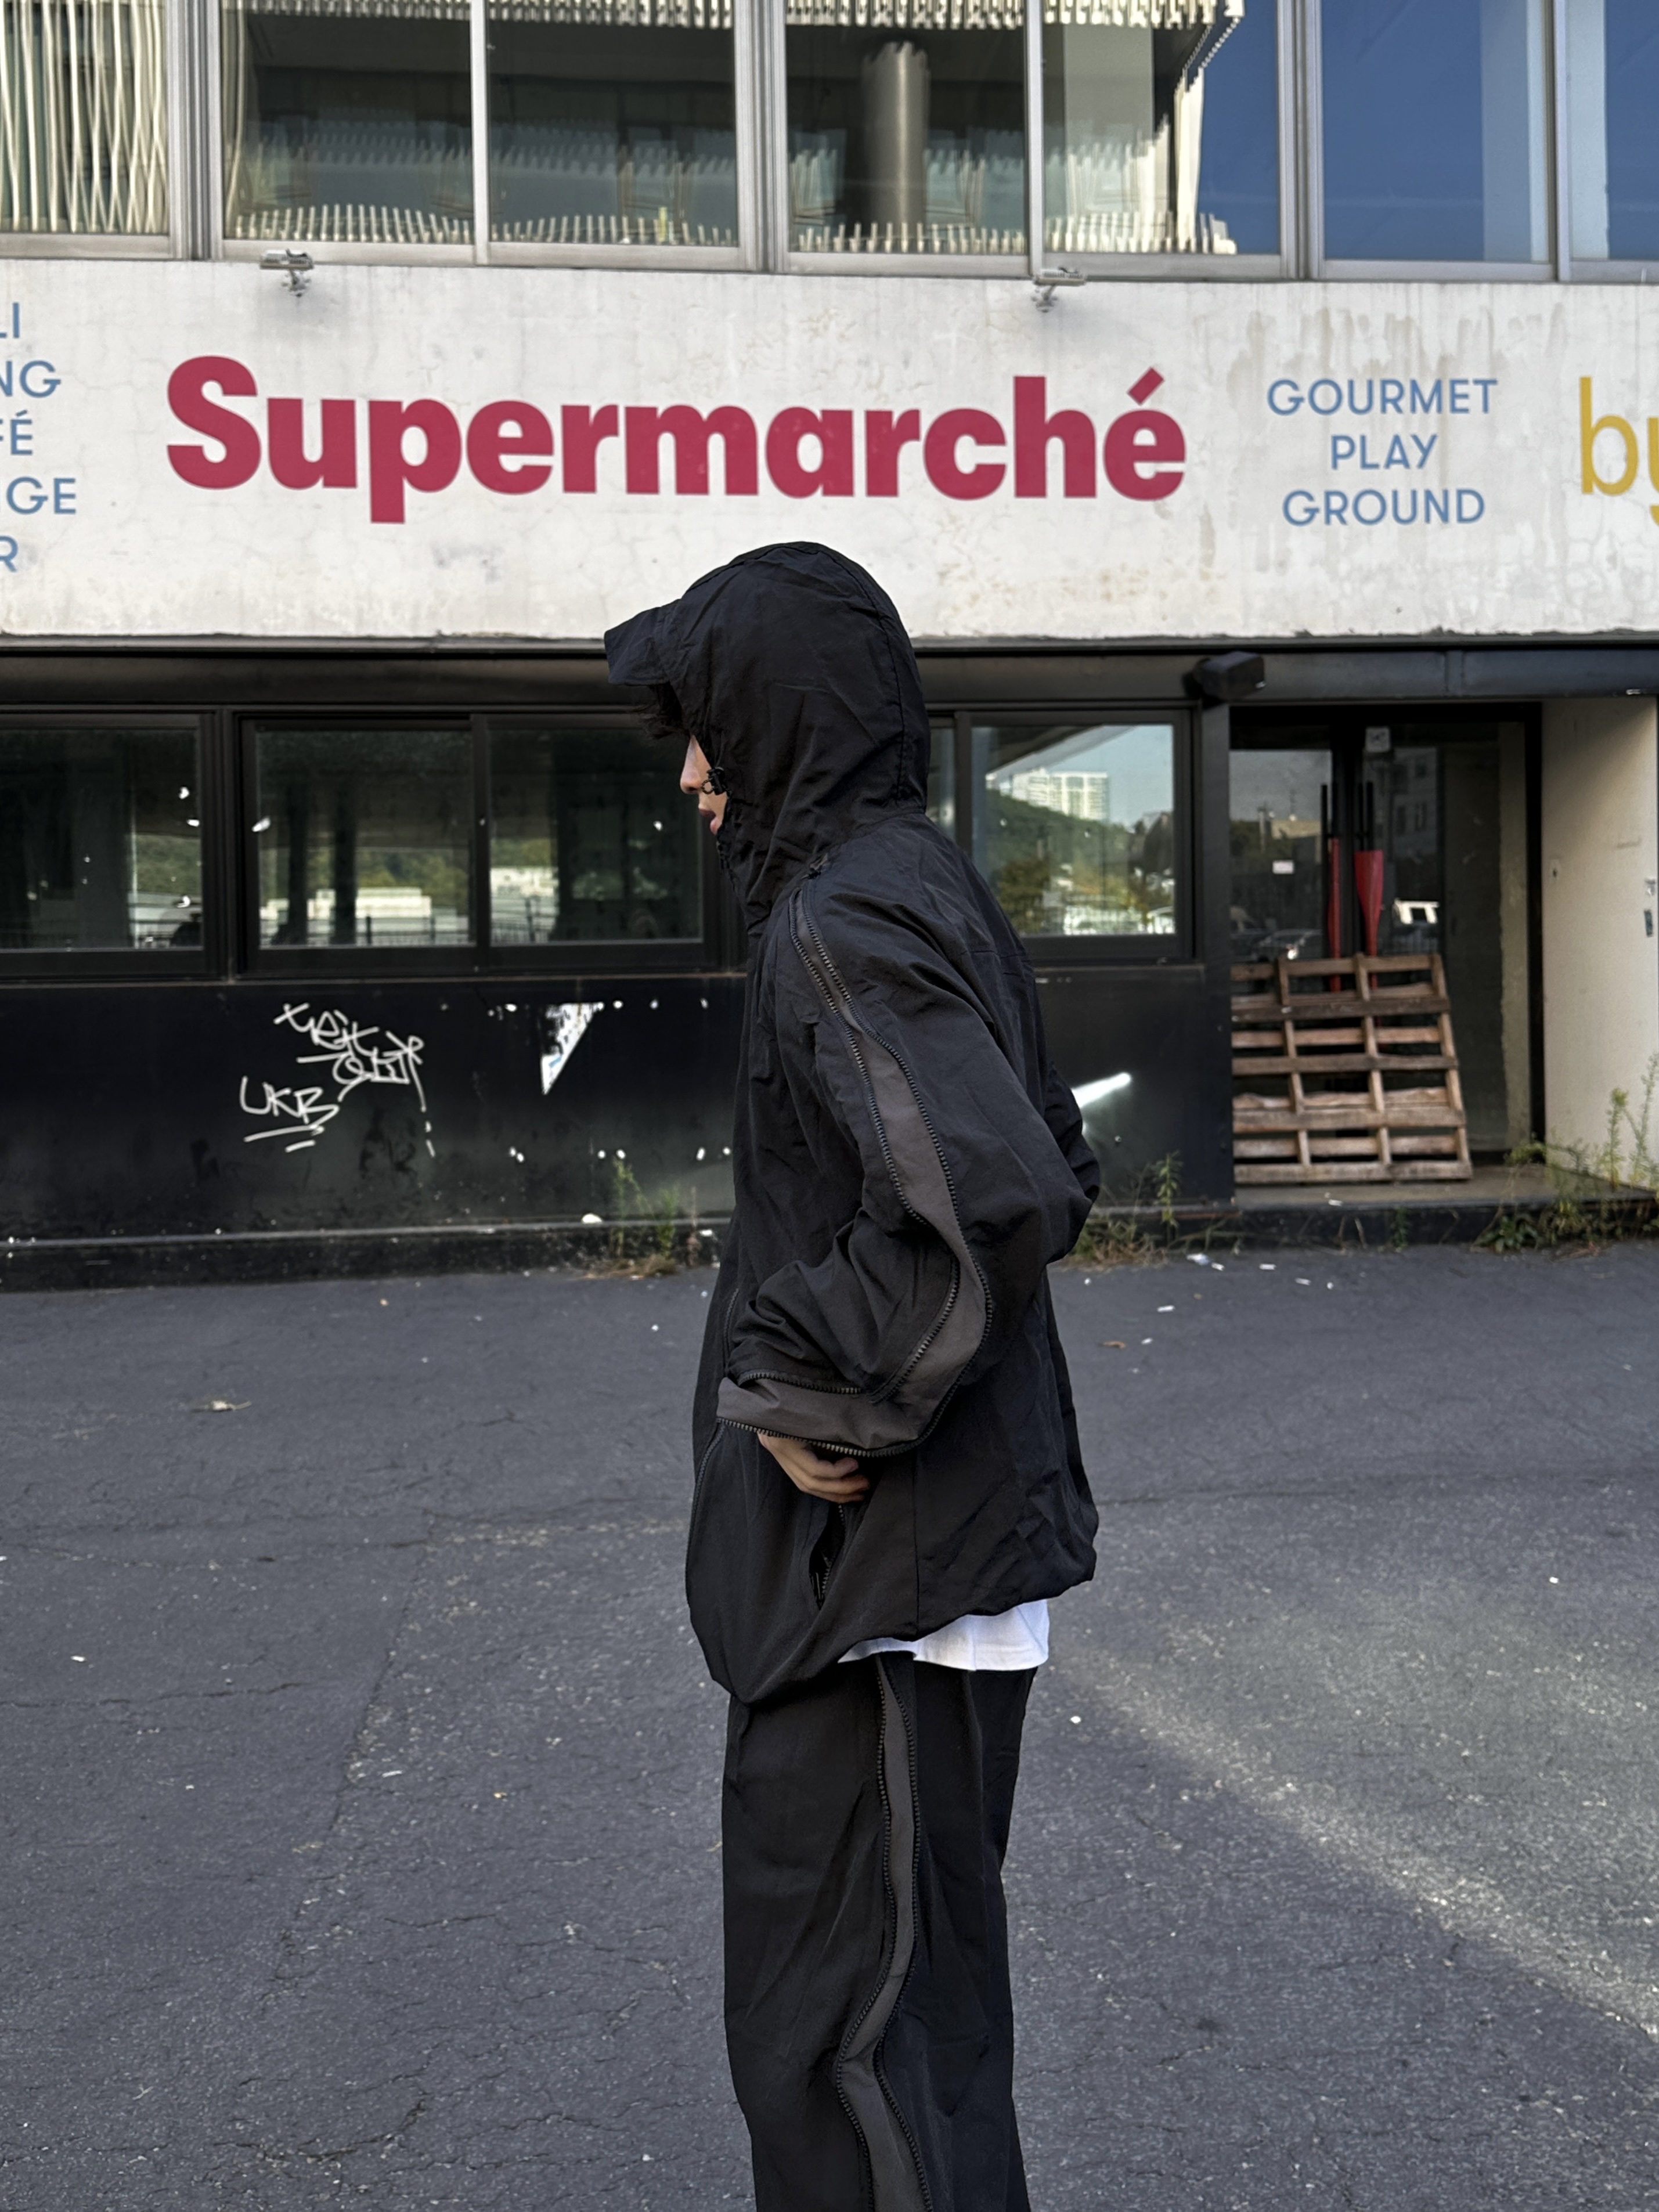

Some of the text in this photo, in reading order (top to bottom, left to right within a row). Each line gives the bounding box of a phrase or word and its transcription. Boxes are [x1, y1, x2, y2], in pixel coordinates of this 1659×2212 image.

[0, 302, 20, 339] I
[1267, 377, 1498, 416] GOURMET
[167, 355, 1186, 524] Supermarché
[1330, 434, 1438, 470] PLAY
[1579, 376, 1659, 527] b
[1282, 488, 1485, 527] GROUND
